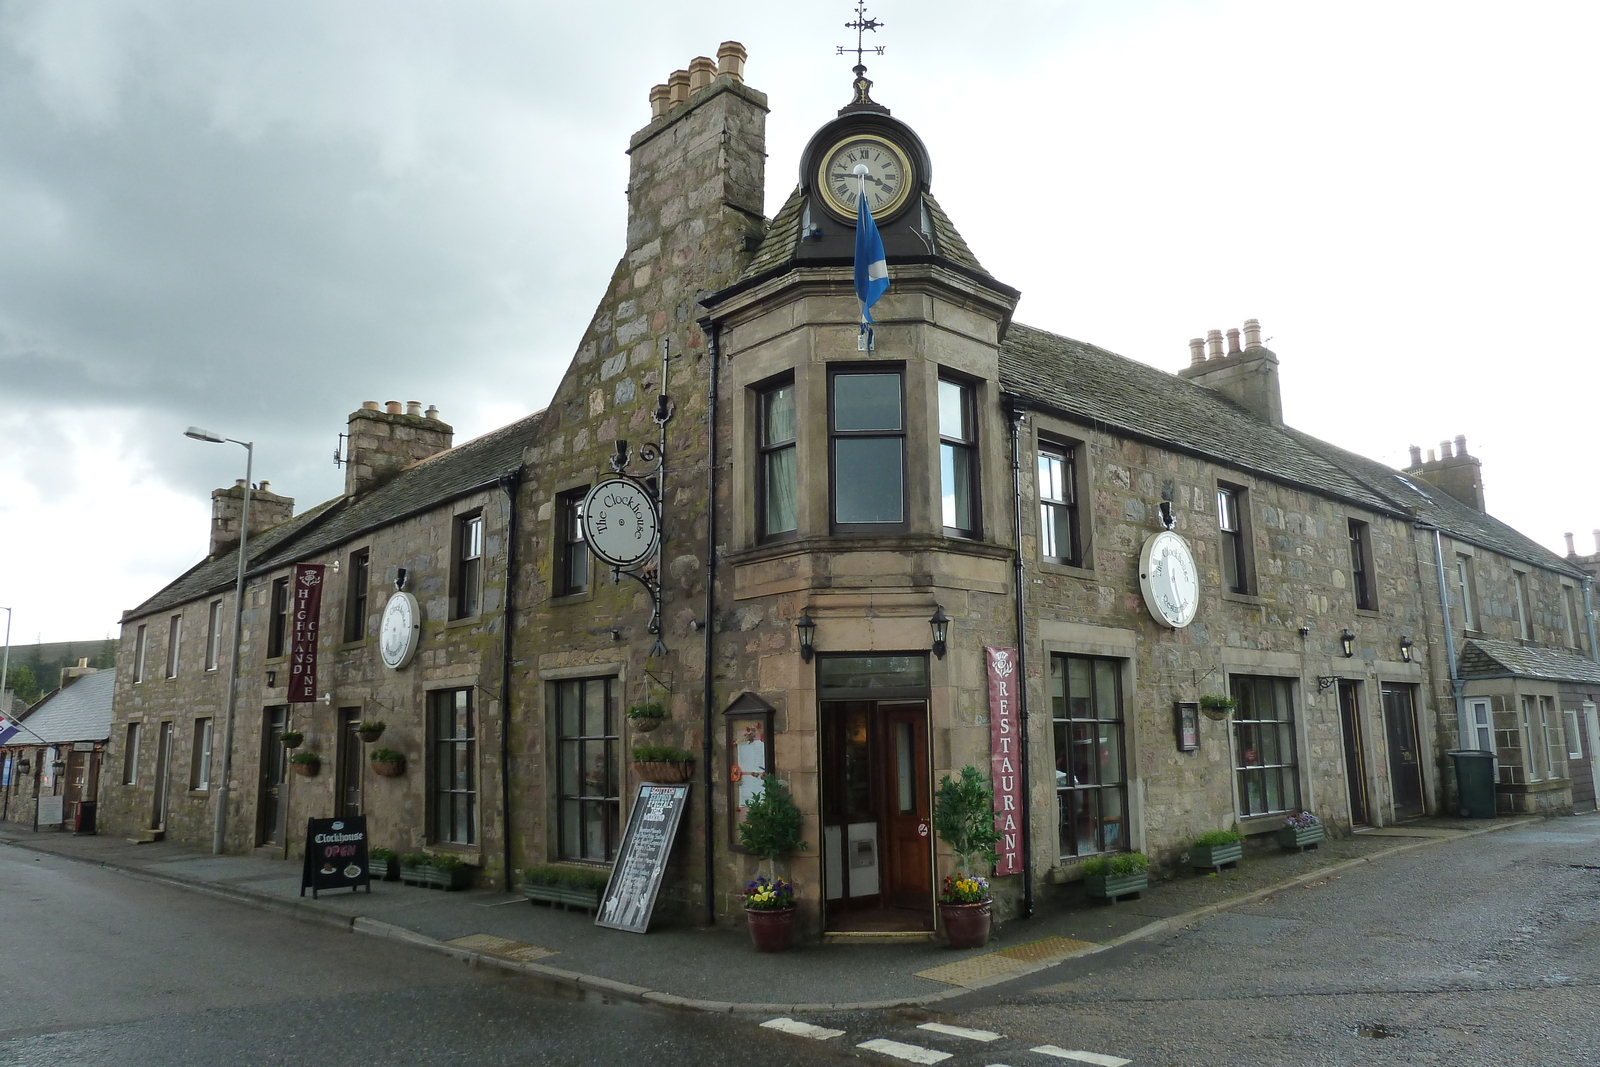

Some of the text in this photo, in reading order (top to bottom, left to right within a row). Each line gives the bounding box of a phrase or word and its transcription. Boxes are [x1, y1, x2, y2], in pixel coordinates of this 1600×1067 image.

[874, 45, 887, 56] W
[847, 153, 857, 164] XI
[859, 149, 870, 159] XII
[595, 492, 646, 540] The Clockhouse
[1155, 546, 1189, 583] The Clockhouse
[293, 589, 309, 674] HIGHLAND
[303, 621, 317, 696] CUISINE
[998, 681, 1016, 869] RESTAURANT
[650, 787, 676, 795] SCOTTISH
[646, 800, 674, 809] SPECIALS
[650, 807, 664, 815] THIS
[314, 831, 364, 844] Clockhouse
[324, 844, 356, 858] OPEN
